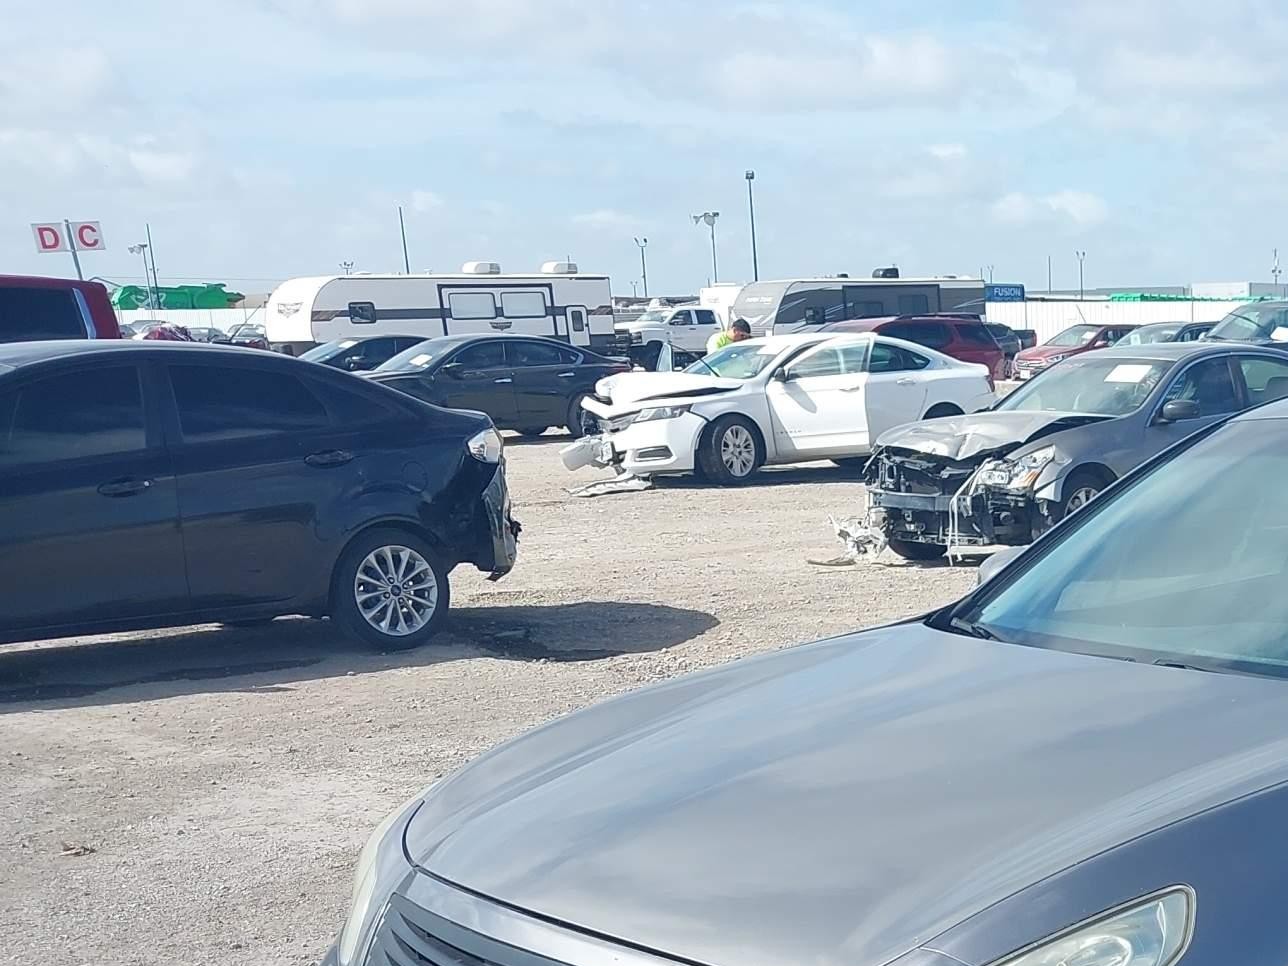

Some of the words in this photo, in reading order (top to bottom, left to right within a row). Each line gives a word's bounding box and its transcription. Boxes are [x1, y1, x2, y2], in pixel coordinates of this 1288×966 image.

[37, 226, 60, 249] D
[78, 224, 99, 247] C
[993, 287, 1021, 297] FUSION
